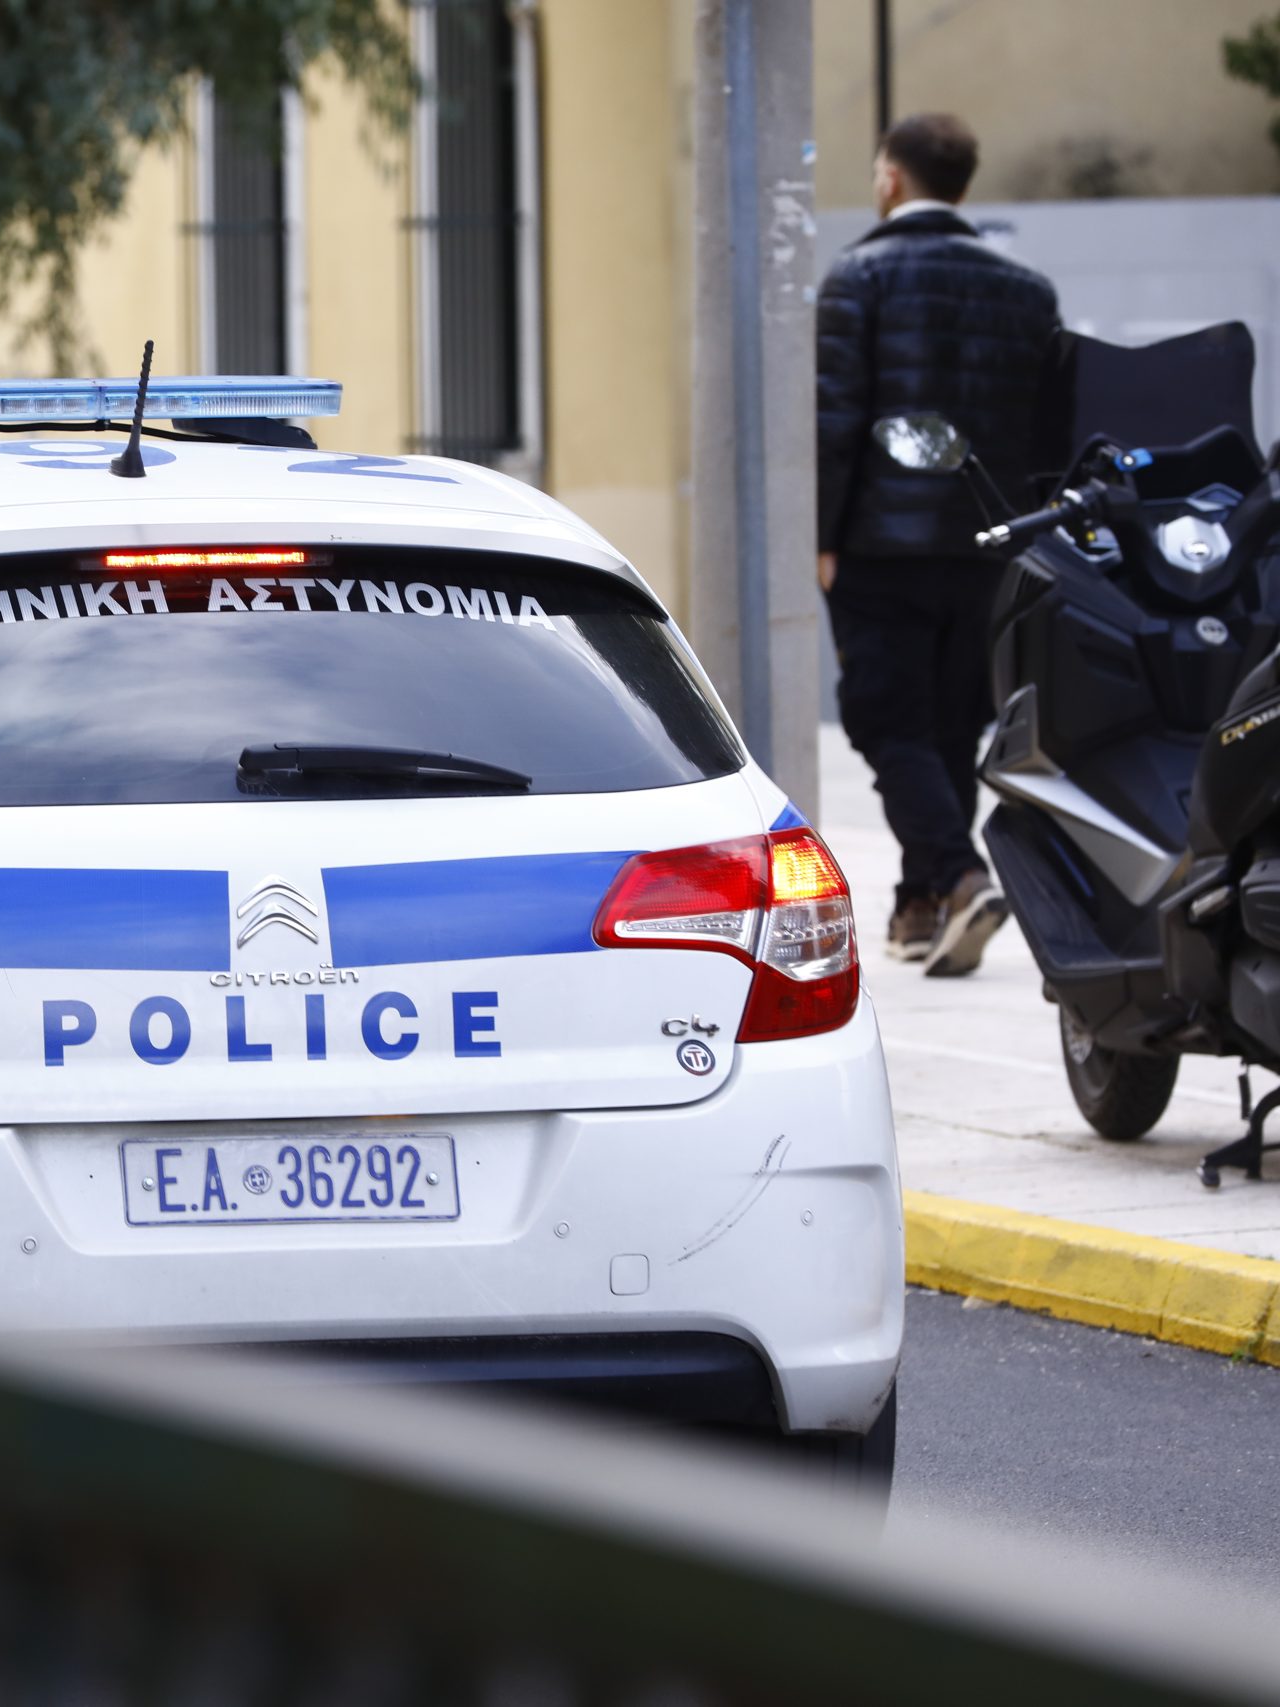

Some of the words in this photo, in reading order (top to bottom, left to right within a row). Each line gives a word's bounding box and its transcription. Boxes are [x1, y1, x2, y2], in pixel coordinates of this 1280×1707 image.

[207, 577, 558, 632] ΑΣΤΥΝΟΜΙΑ
[42, 991, 502, 1067] POLICE
[661, 1013, 720, 1038] C4
[277, 1145, 425, 1210] 36292
